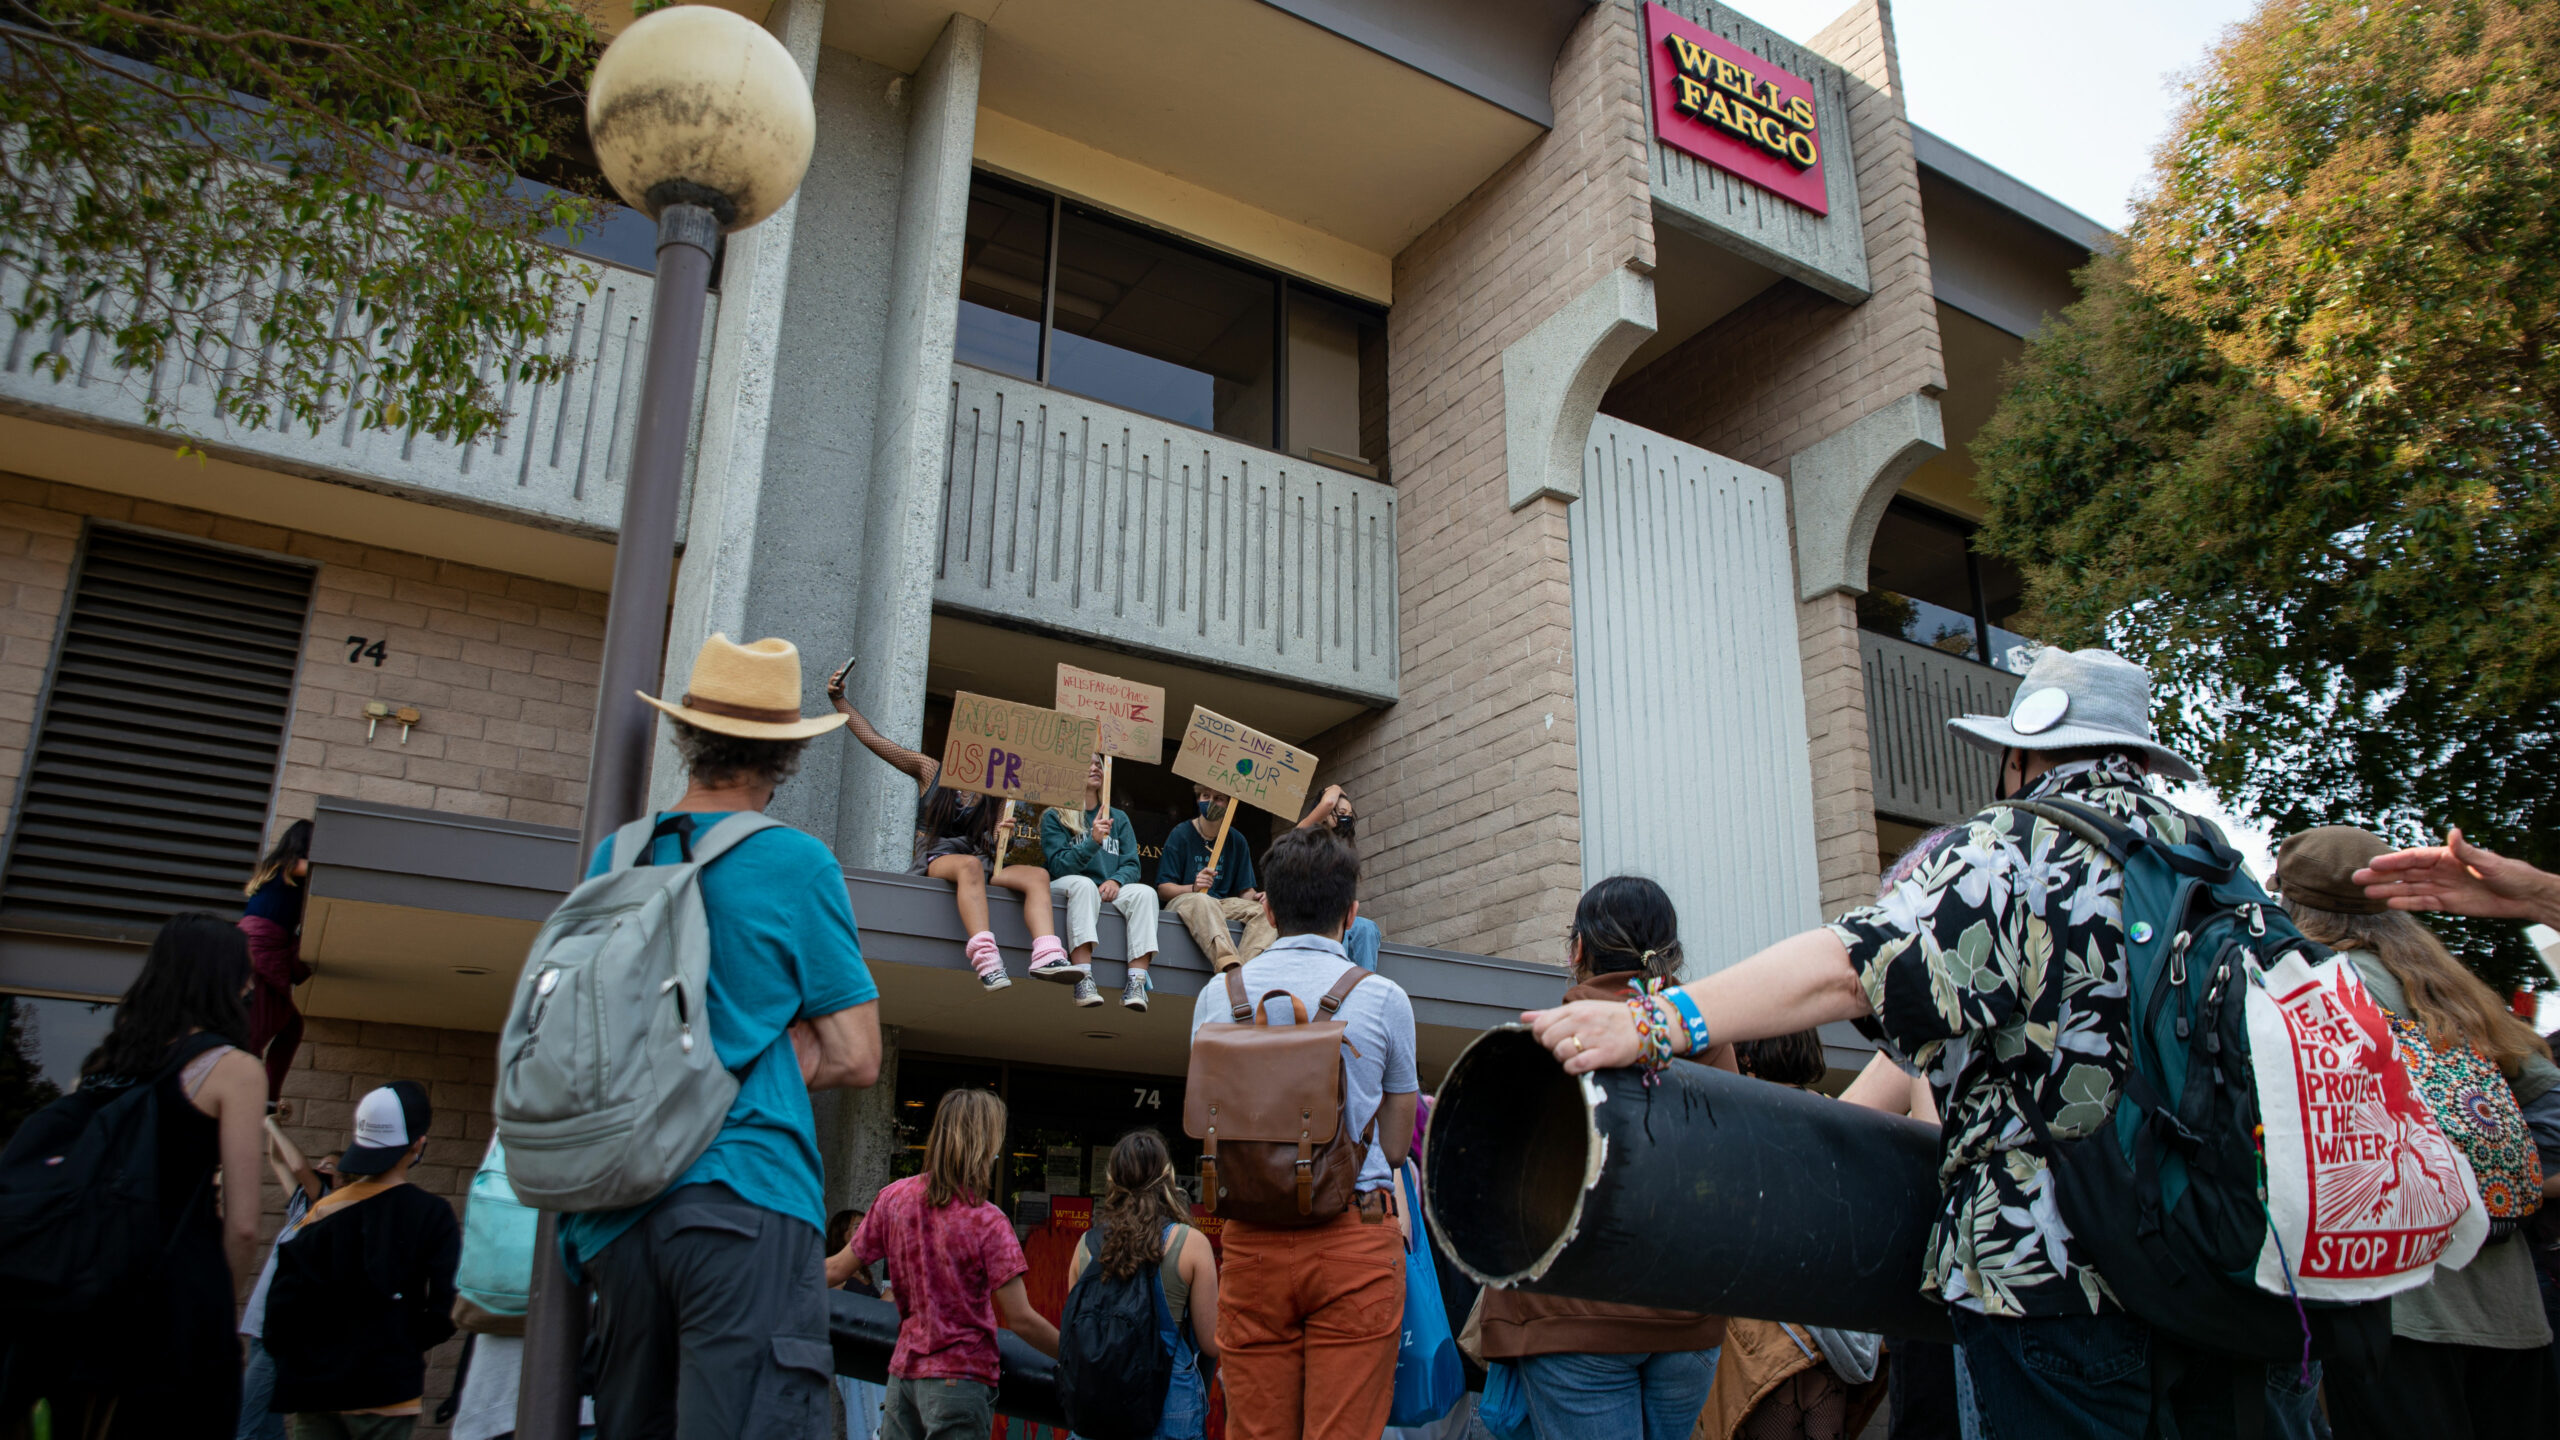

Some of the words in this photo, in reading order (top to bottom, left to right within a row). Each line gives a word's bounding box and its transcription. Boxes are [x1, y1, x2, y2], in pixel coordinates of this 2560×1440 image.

[1665, 32, 1816, 131] WELLS
[1673, 73, 1818, 168] FARGO
[346, 635, 388, 667] 74
[956, 697, 1098, 764] NATURE
[1186, 730, 1230, 766] SAVE
[1198, 714, 1235, 734] STOP
[1240, 730, 1276, 755] LINE
[1284, 750, 1294, 764] 3
[946, 739, 984, 784] IS
[1207, 765, 1268, 800] EARTH
[2301, 1044, 2340, 1070] TO
[1133, 1088, 1161, 1110] 74
[2305, 1070, 2386, 1104] PROTECT
[2311, 1104, 2355, 1133] THE
[2315, 1134, 2390, 1165] WATER
[1193, 1216, 1225, 1226] WELLS
[2310, 1235, 2388, 1273] STOP
